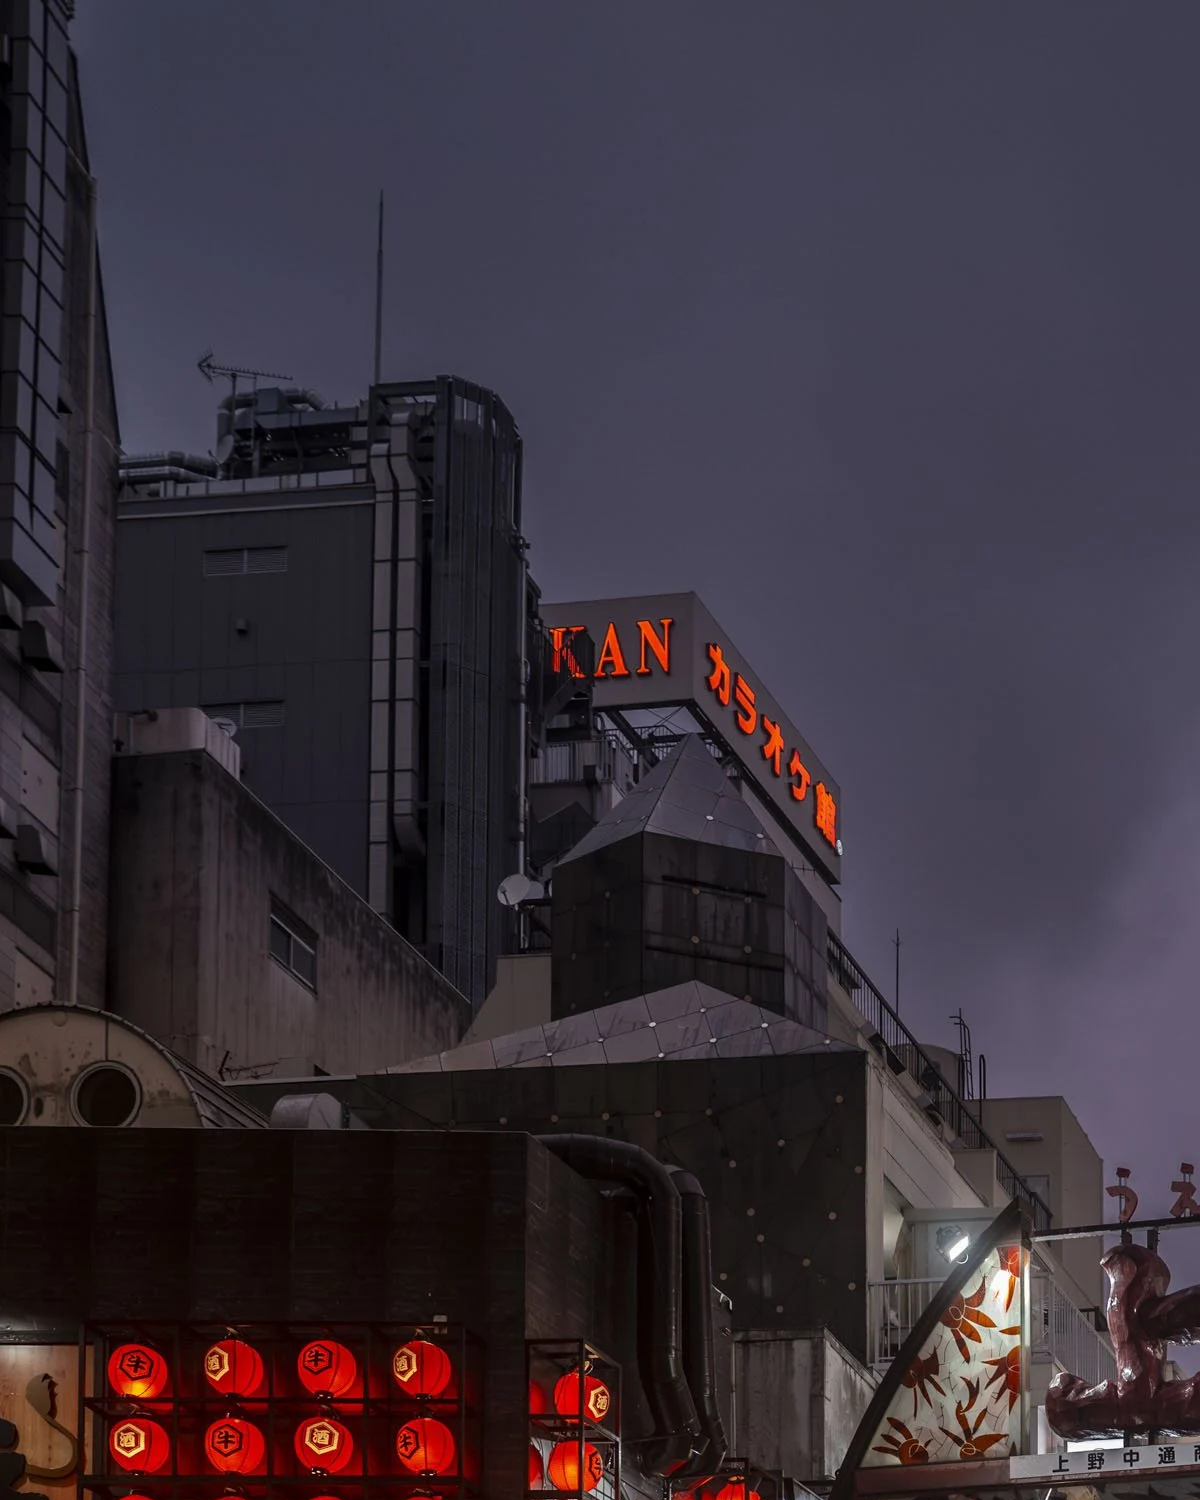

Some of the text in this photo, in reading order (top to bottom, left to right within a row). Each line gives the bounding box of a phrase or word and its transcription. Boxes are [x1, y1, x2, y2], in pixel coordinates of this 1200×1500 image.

[706, 642, 838, 848] カラオケ館
